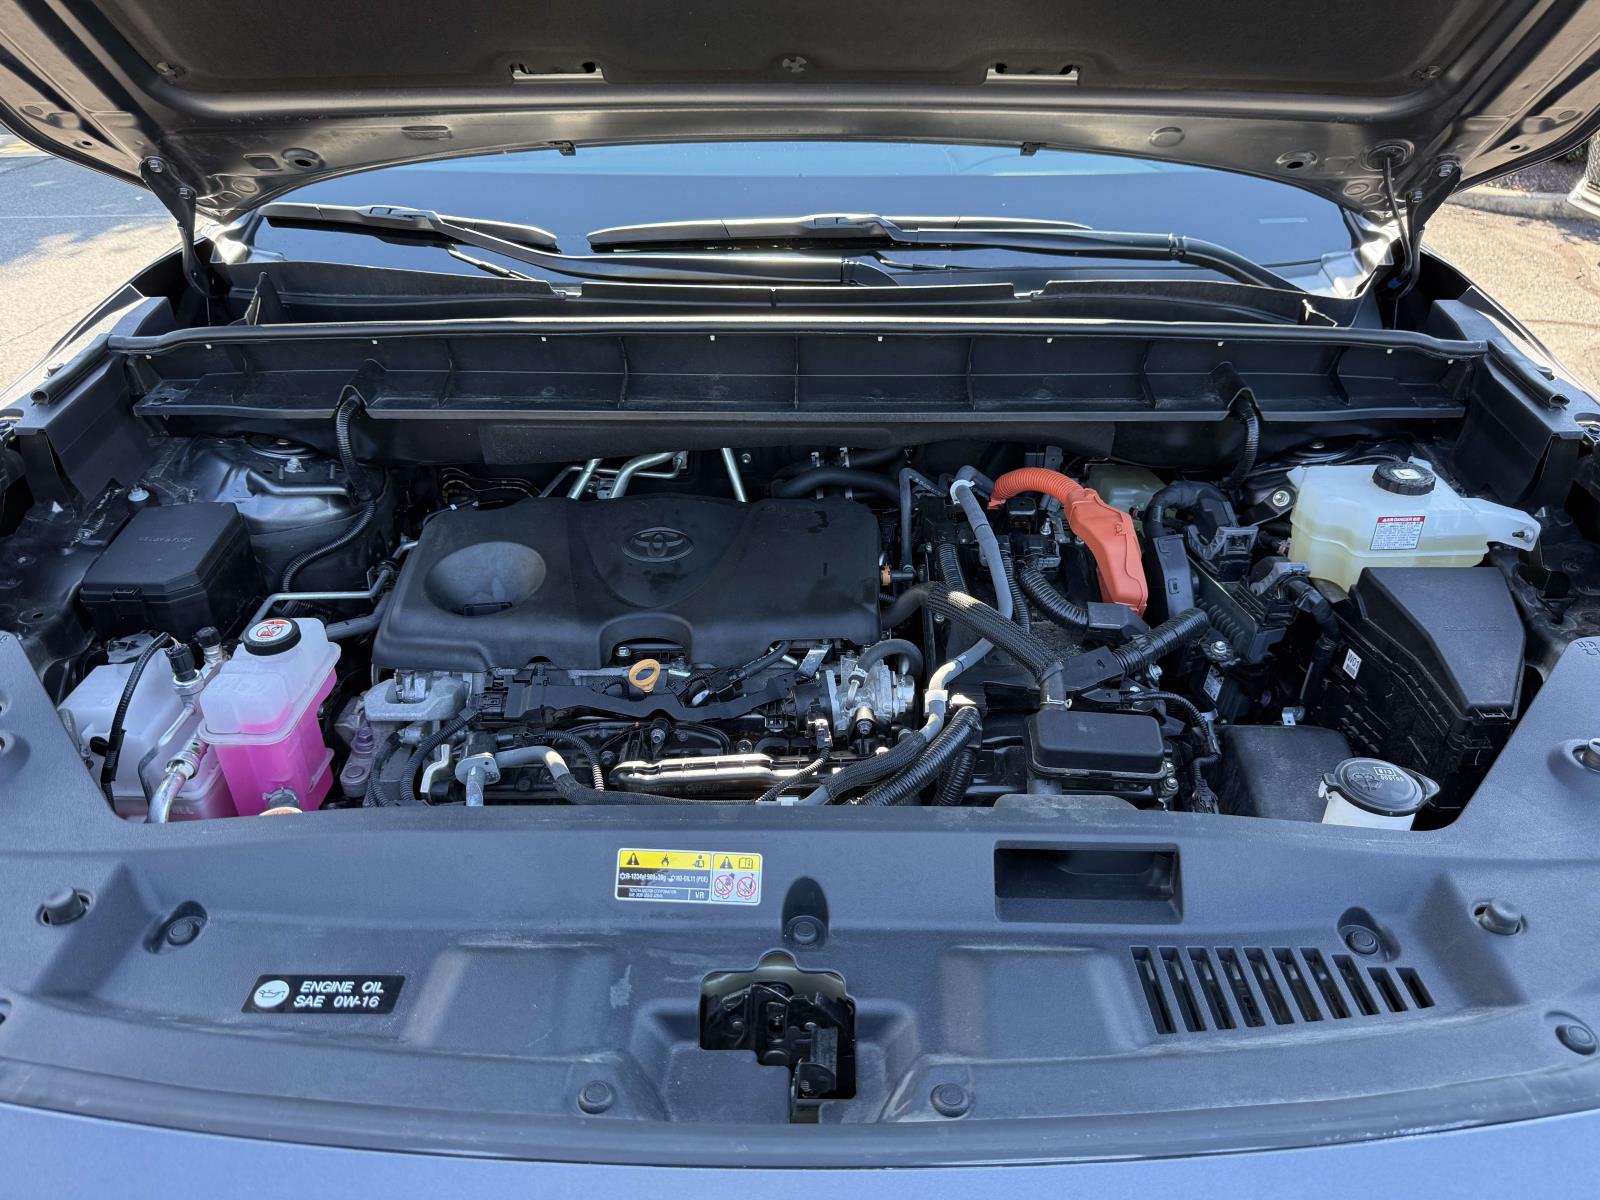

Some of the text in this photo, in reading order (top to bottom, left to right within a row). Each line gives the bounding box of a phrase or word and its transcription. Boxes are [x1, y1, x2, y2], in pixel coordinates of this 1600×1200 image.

[695, 891, 705, 899] VR
[300, 980, 385, 993] ENGINE OIL
[293, 995, 380, 1008] SAE 0W-16
